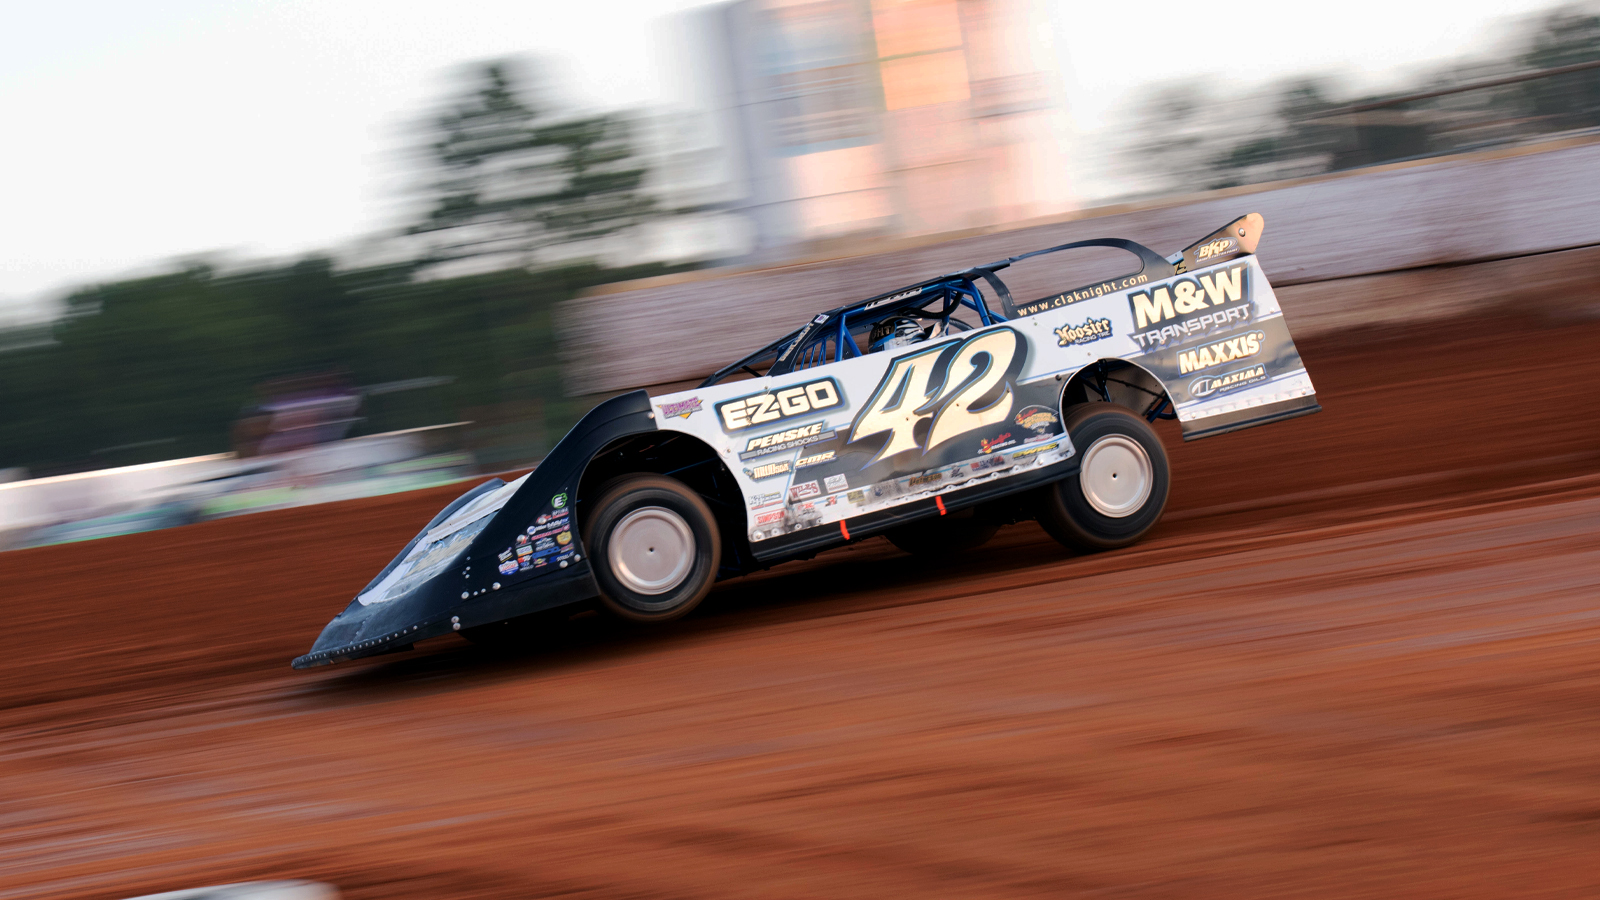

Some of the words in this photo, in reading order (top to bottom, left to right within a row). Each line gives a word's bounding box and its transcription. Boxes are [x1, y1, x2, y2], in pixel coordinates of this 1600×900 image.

[1199, 239, 1230, 258] BKP
[1017, 274, 1148, 316] www.claknight.com
[1132, 267, 1242, 329] M&W
[1055, 318, 1111, 346] Hoosier
[1133, 304, 1250, 348] TRANSPORT
[1179, 333, 1261, 375] MAXXIS
[1211, 366, 1265, 389] MAXIMA
[1219, 381, 1248, 393] RACING
[1248, 375, 1266, 385] OILS
[849, 328, 1014, 468] 42
[746, 422, 824, 452] PENSKE
[756, 443, 787, 457] RACING
[787, 435, 819, 449] SHOCKS
[757, 510, 786, 524] SIMPSON
